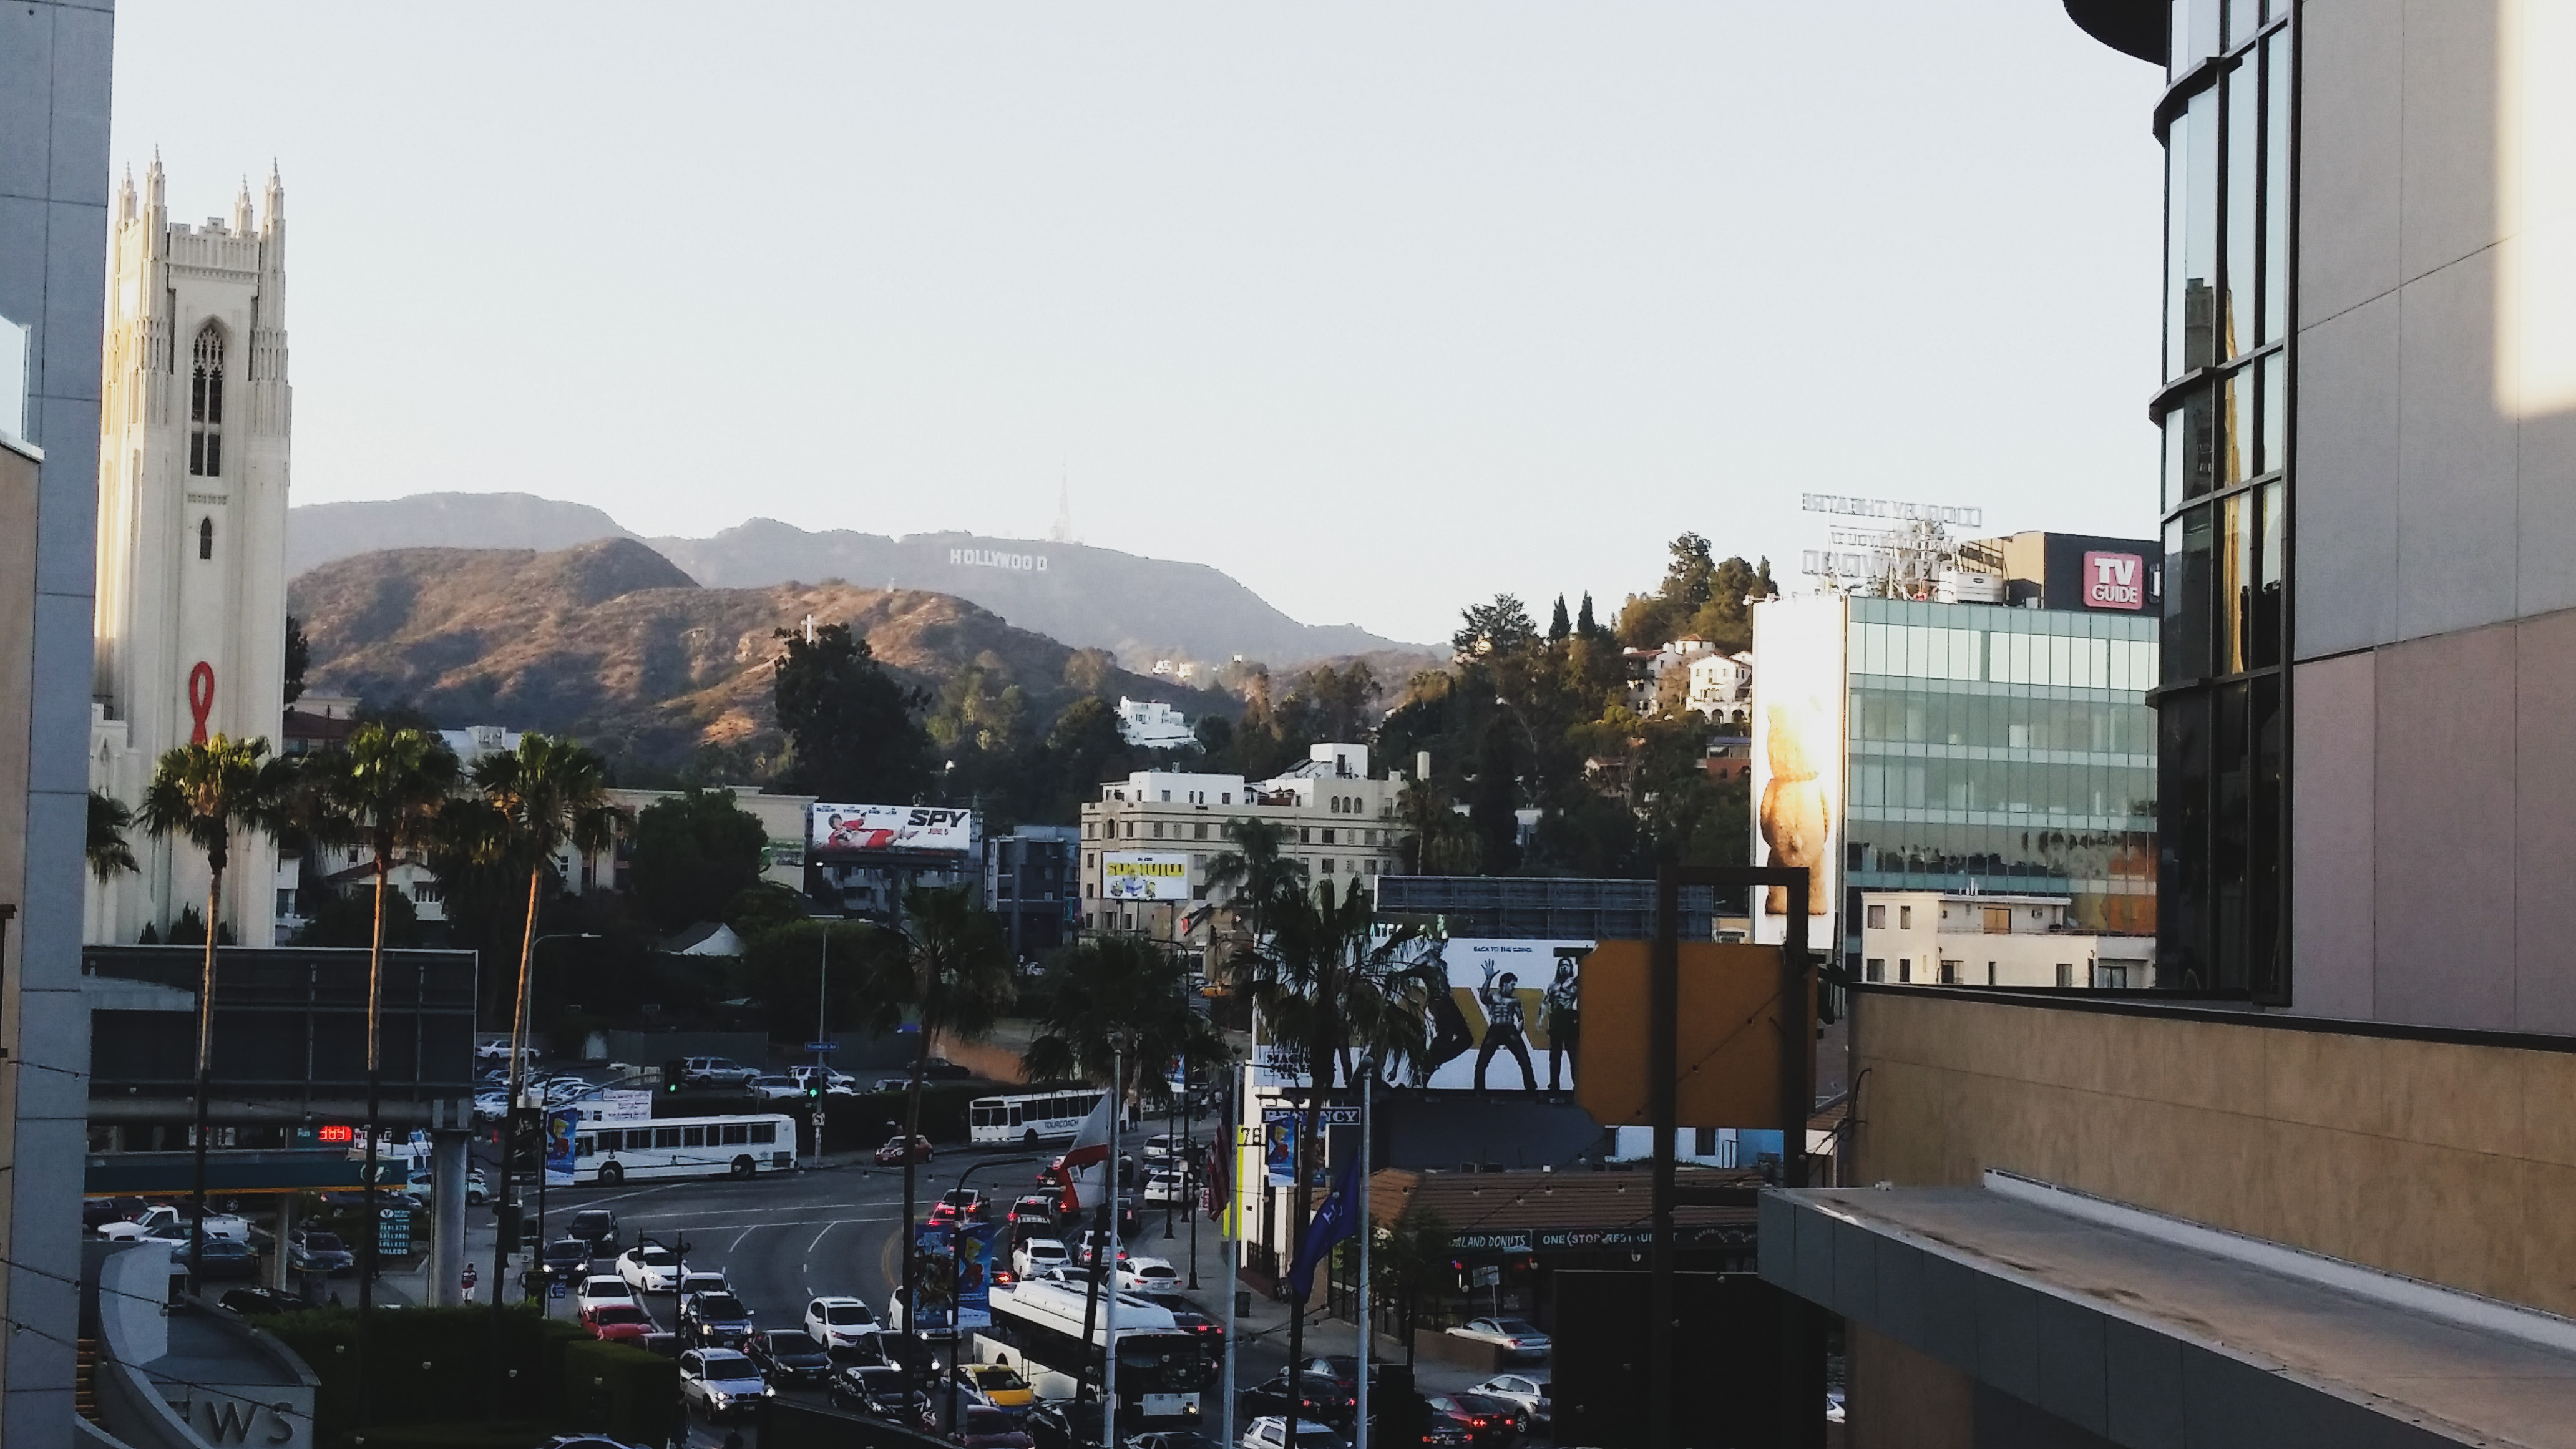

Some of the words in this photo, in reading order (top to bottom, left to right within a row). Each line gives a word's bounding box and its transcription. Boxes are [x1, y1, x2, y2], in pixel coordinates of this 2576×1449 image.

[950, 549, 1048, 570] HOLLYWOOD
[2094, 557, 2135, 585] TV
[2091, 584, 2138, 603] GUIDE
[908, 810, 968, 827] SPY
[1488, 1235, 1525, 1247] DONUTS
[1543, 1235, 1565, 1245] ONE
